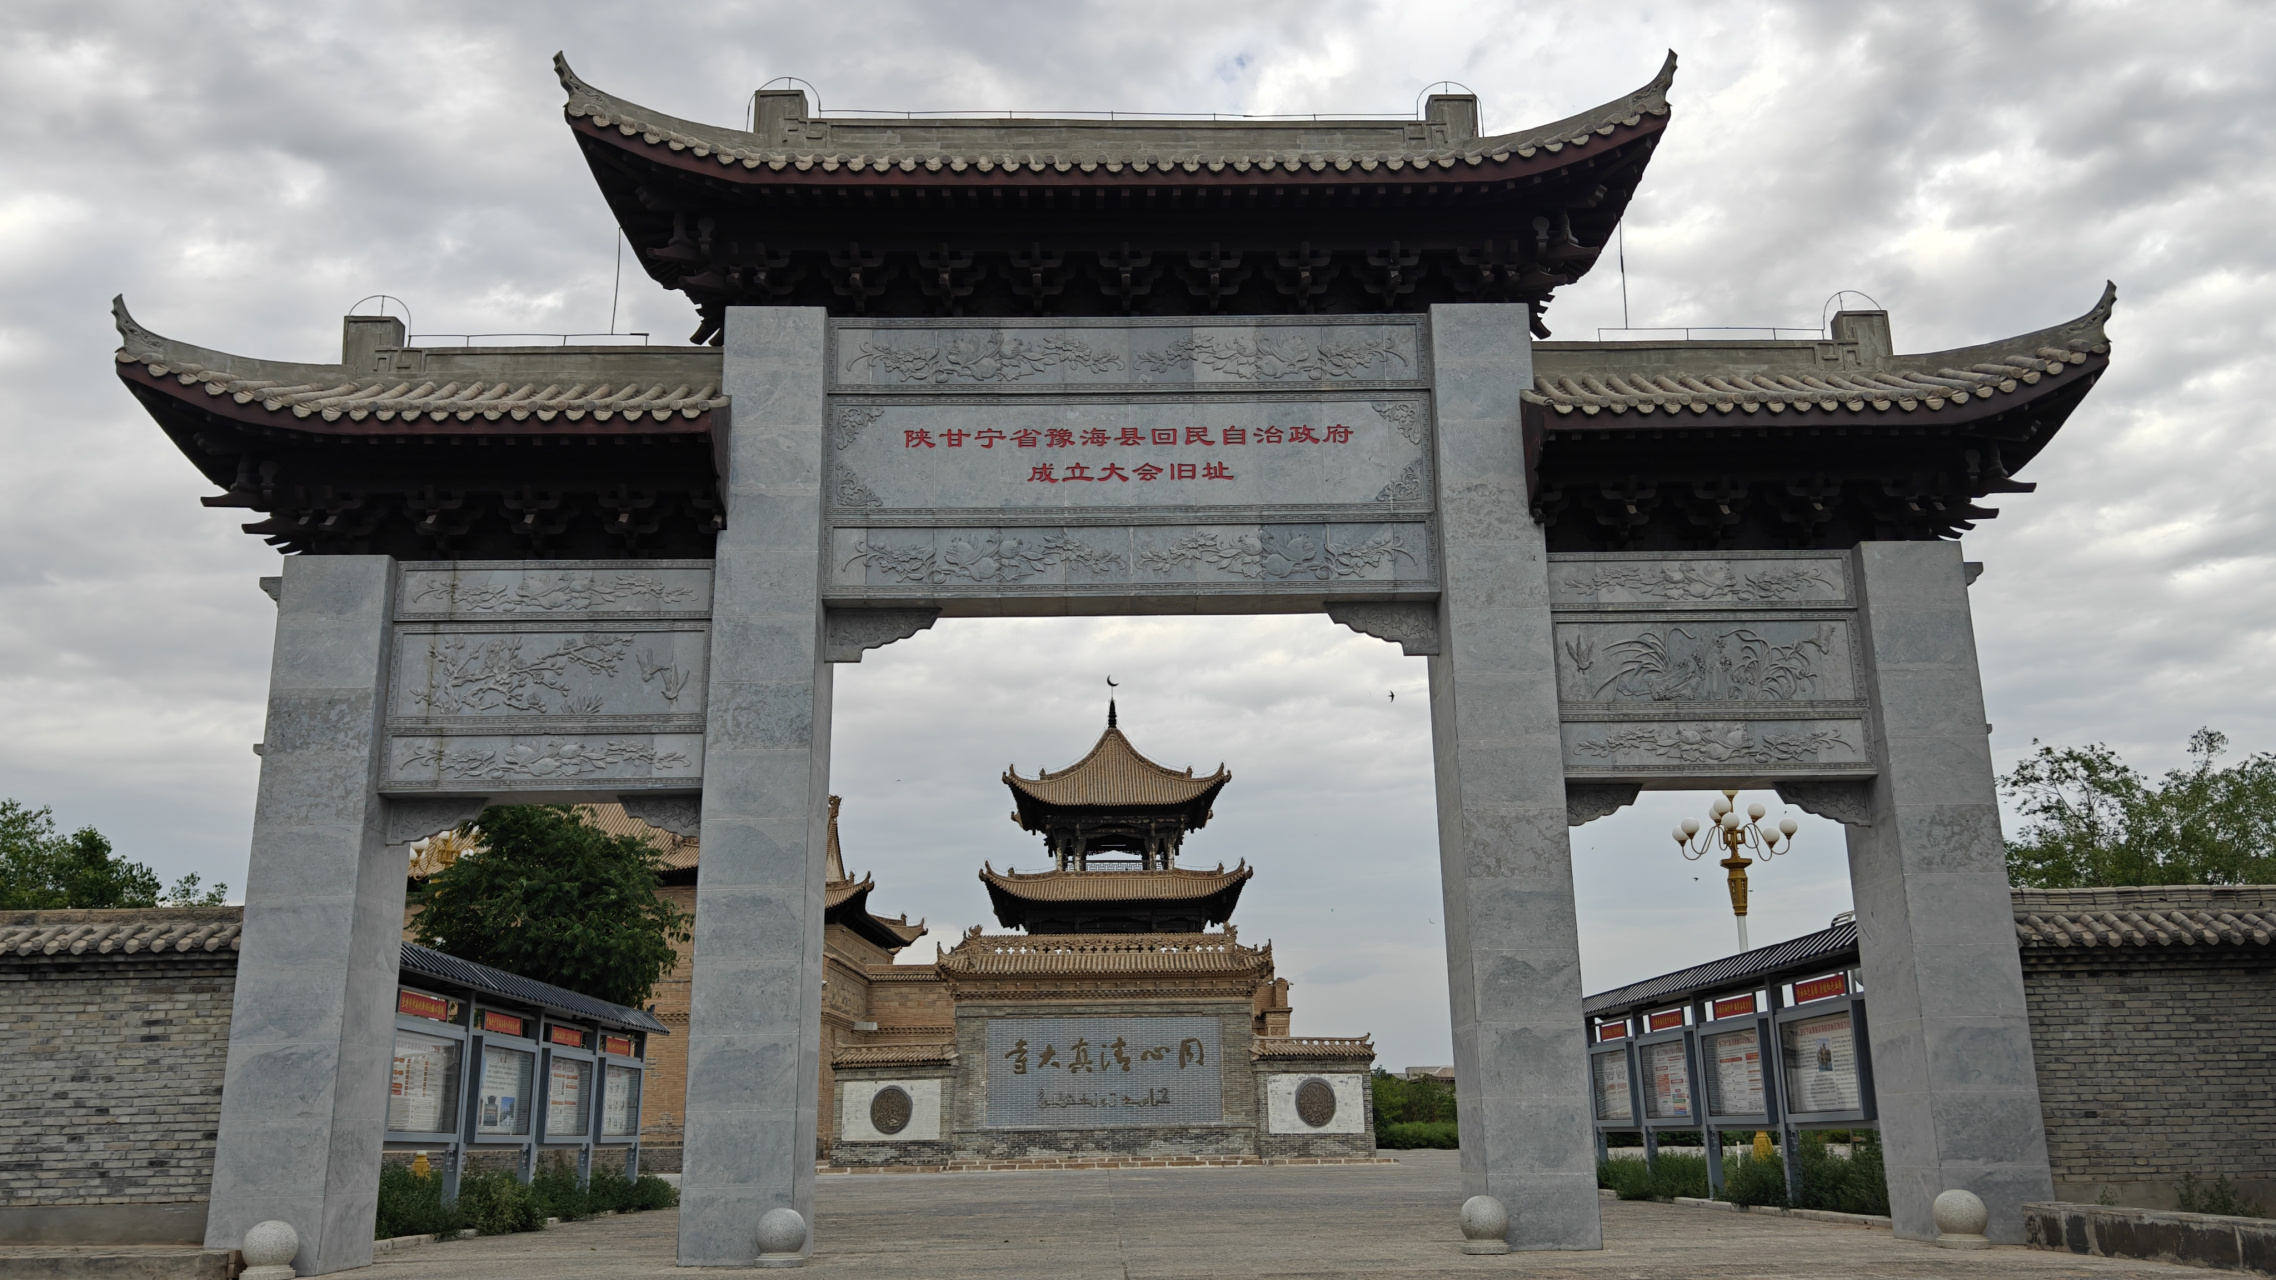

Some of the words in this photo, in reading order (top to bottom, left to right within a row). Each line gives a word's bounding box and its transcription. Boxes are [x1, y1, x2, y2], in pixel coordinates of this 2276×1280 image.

[903, 424, 1354, 449] 陕甘宁省豫海县回民自治政府
[1027, 461, 1234, 483] 成立大会旧址
